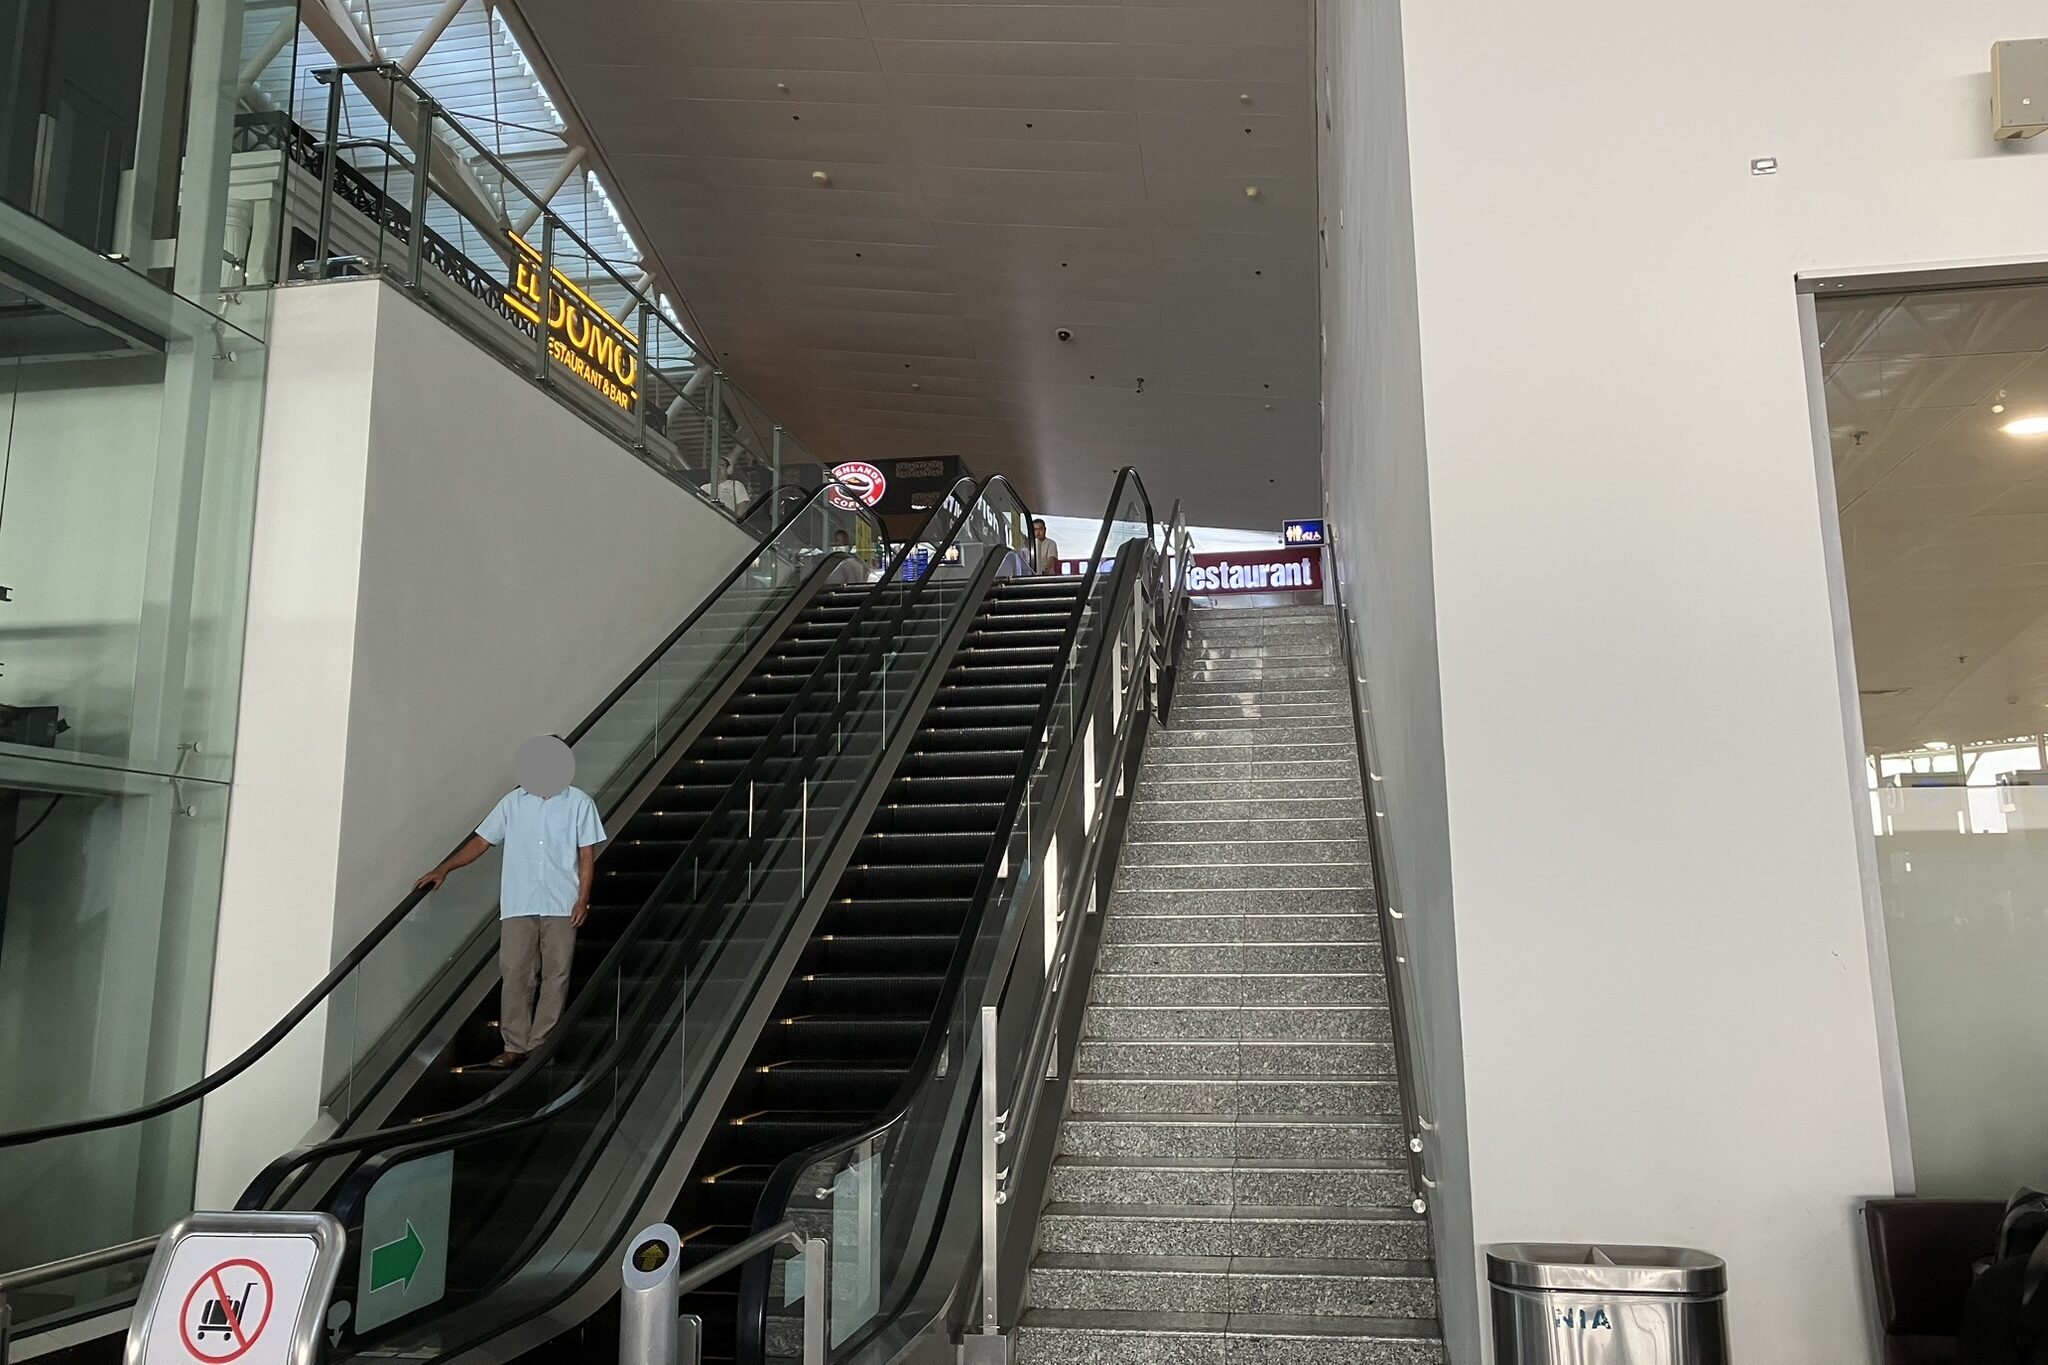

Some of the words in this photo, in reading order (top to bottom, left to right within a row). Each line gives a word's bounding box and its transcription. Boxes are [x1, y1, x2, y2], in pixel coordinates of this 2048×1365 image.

[516, 263, 541, 303] EL
[548, 336, 604, 391] ESTAURANT
[603, 378, 610, 396] &
[609, 383, 629, 410] BAR
[834, 465, 882, 484] GHLANDS
[833, 495, 875, 508] COFE
